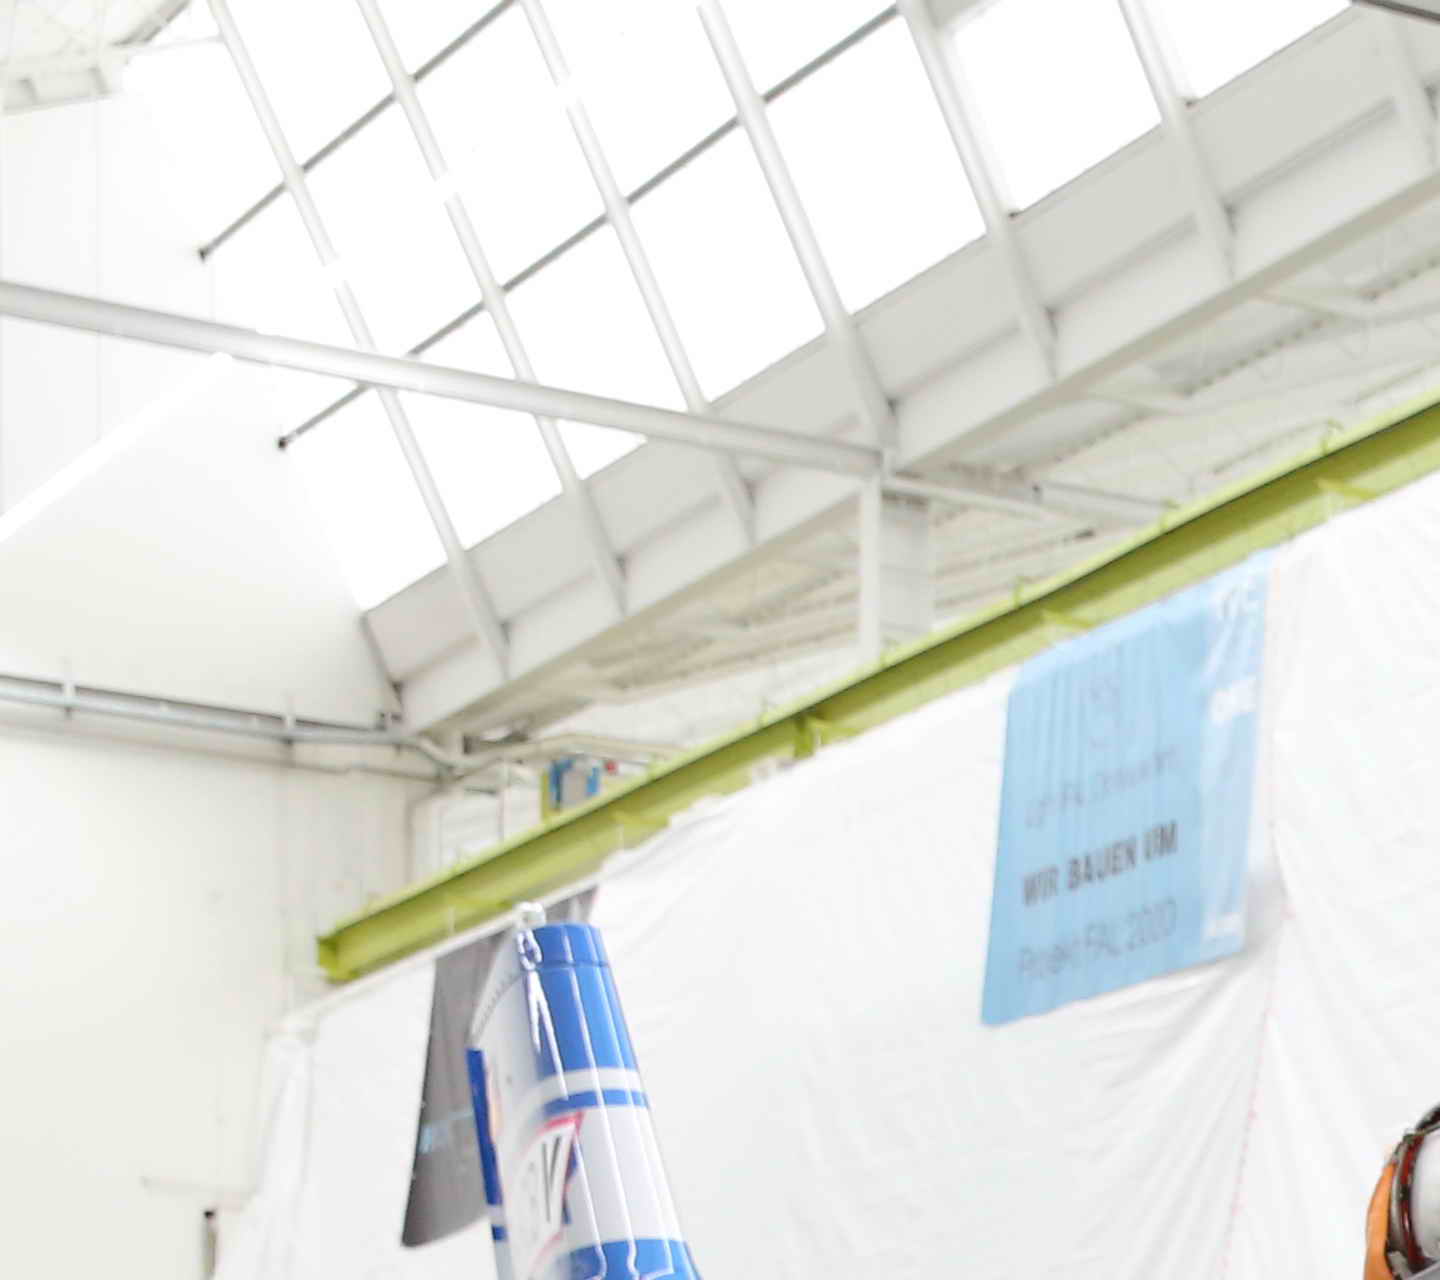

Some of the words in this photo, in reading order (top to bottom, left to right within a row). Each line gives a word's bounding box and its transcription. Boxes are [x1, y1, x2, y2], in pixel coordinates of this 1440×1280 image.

[1022, 866, 1058, 907] WIR
[1067, 835, 1137, 892] BAUEN
[1143, 821, 1179, 863] UM
